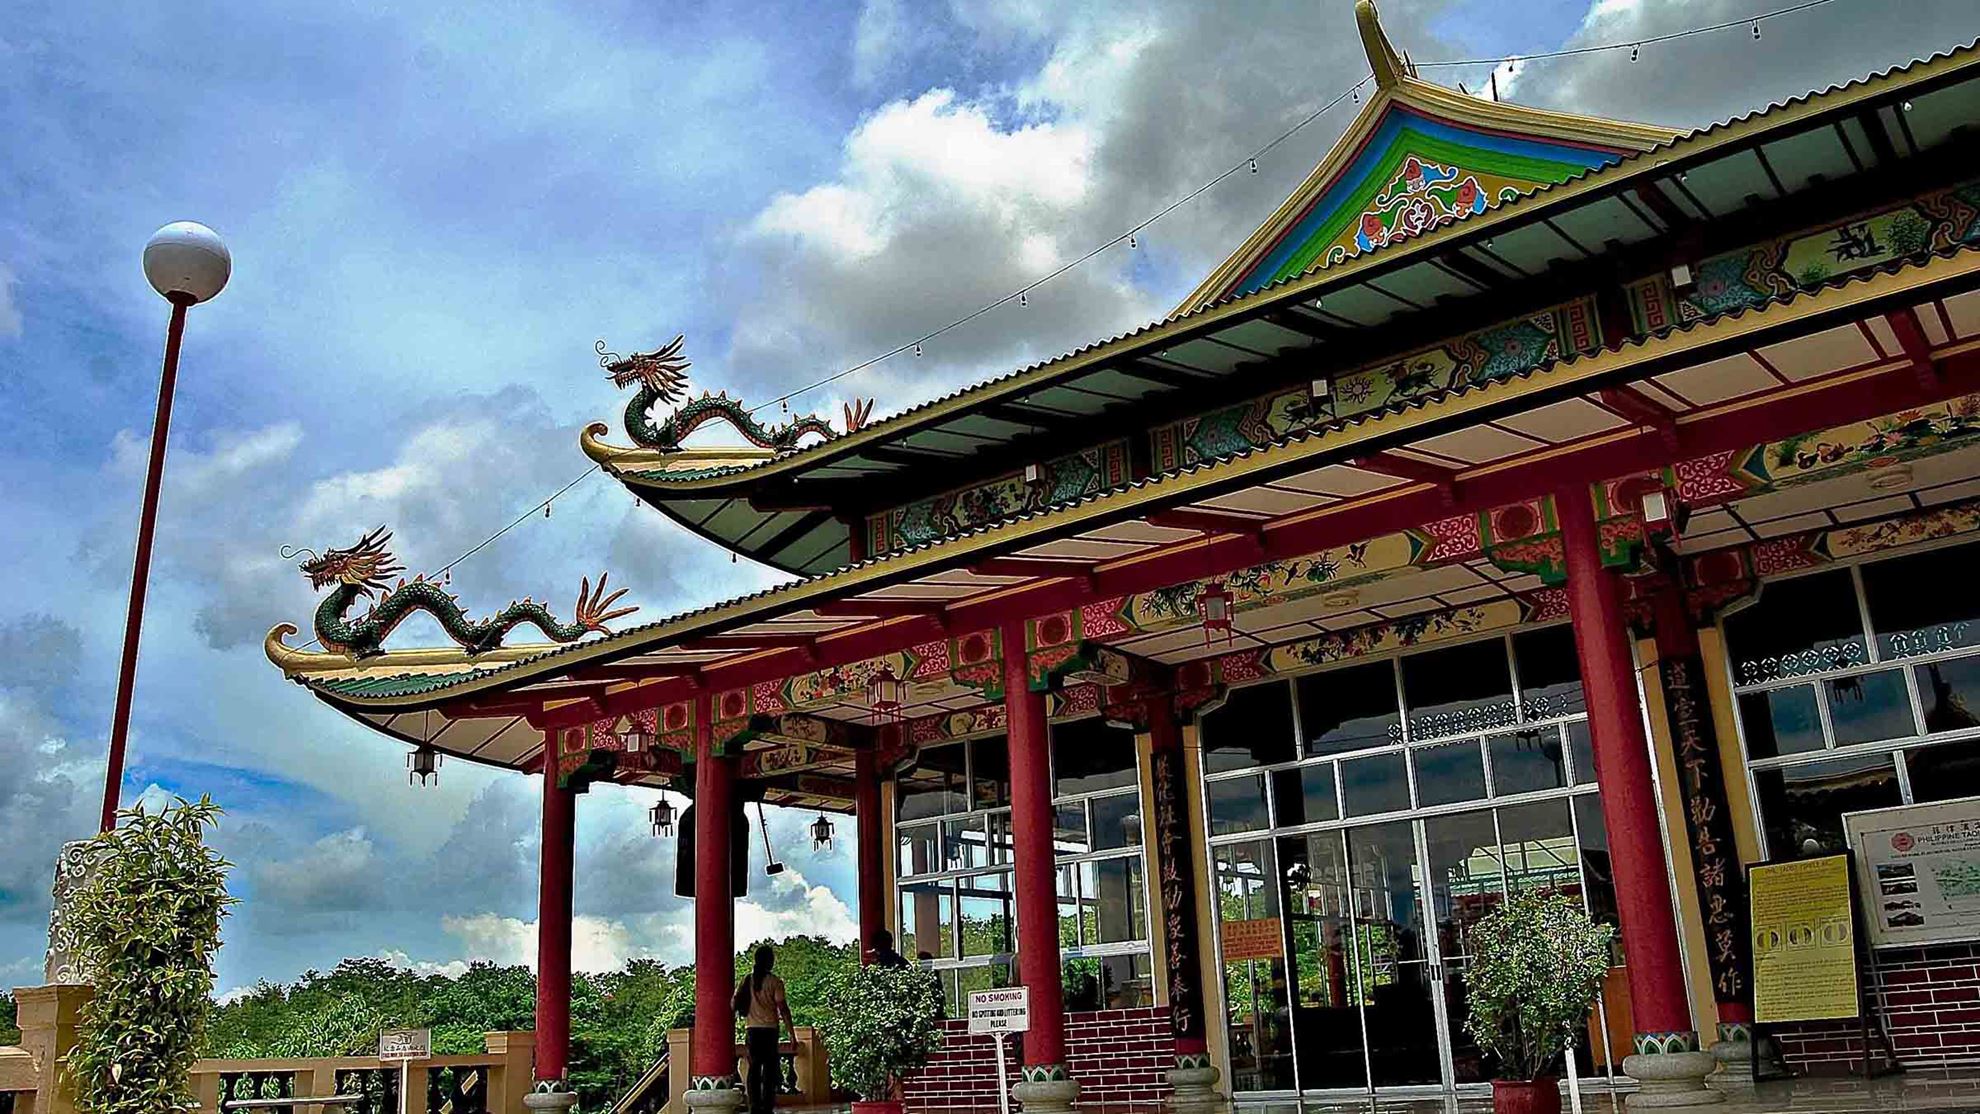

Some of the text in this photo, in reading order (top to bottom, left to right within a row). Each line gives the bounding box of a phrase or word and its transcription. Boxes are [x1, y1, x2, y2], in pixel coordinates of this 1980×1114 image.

[1917, 833, 1960, 843] PHILIPPINE
[975, 991, 1022, 1003] NO SMOKING
[990, 1019, 1007, 1028] PLEASE
